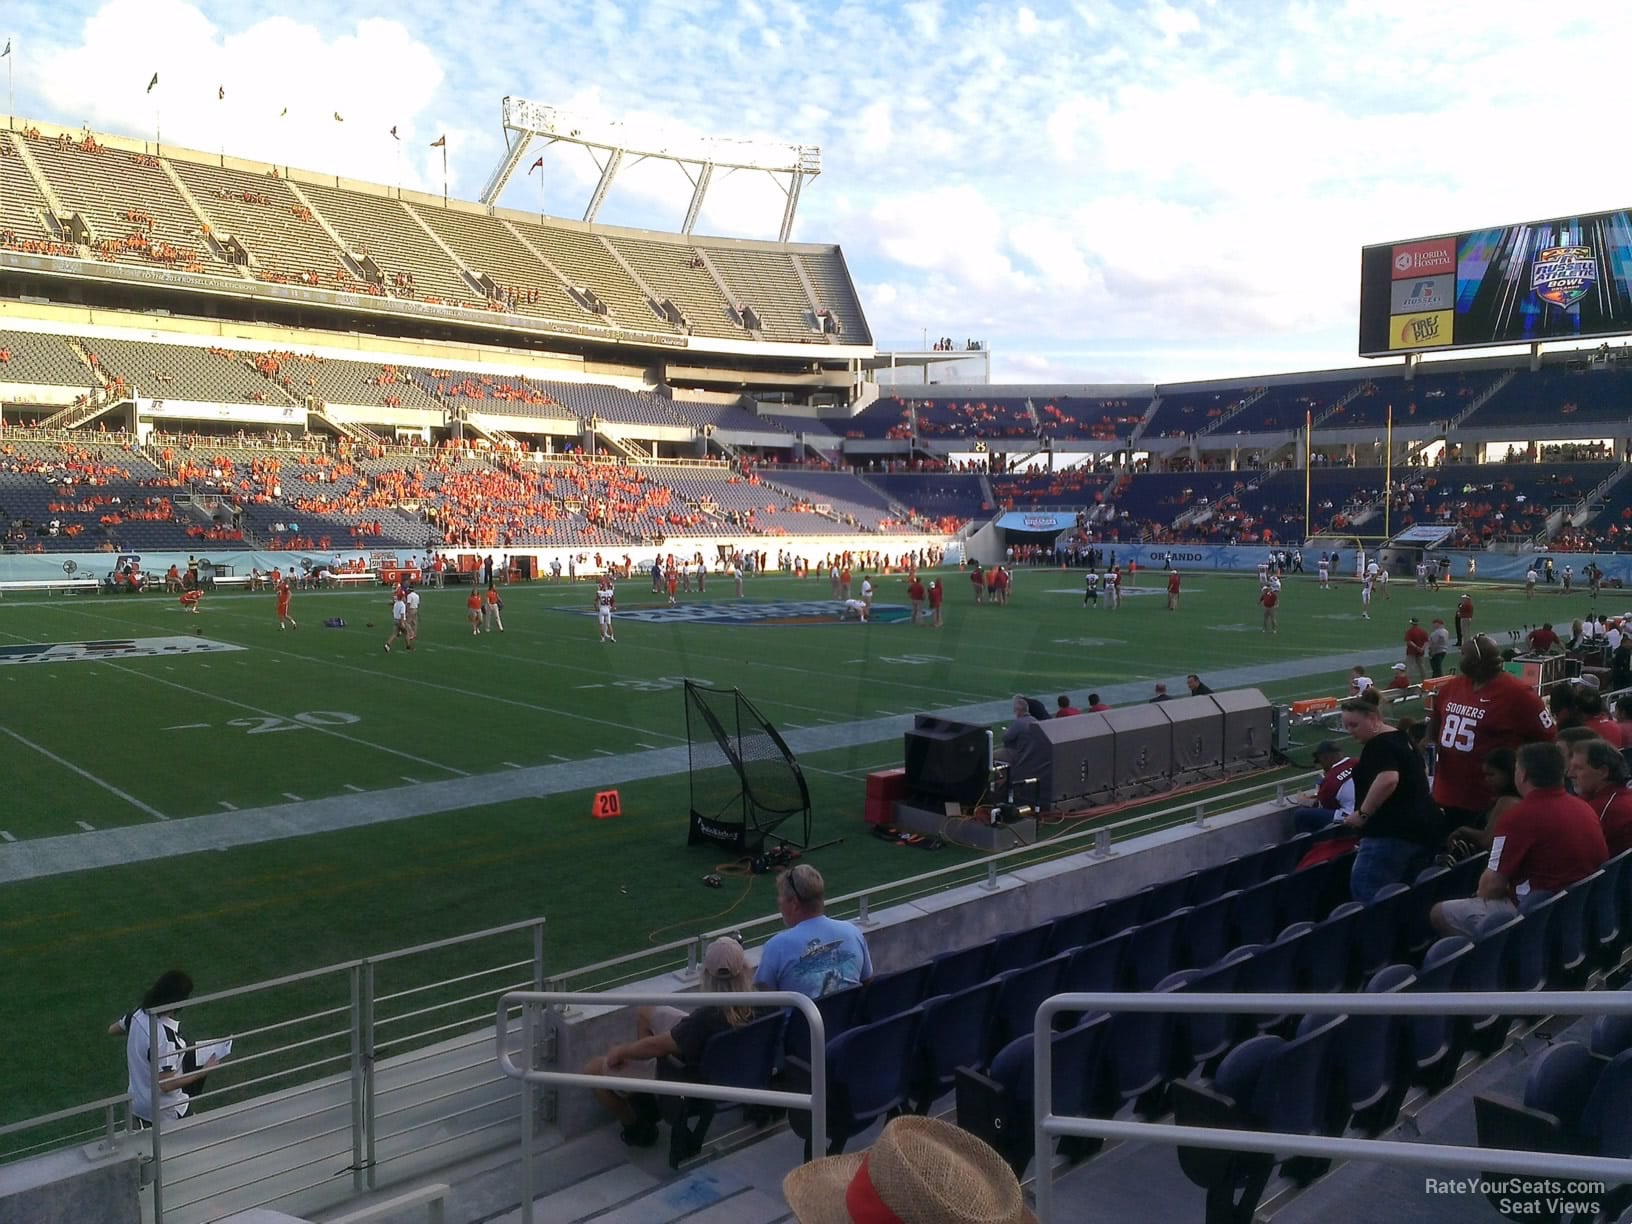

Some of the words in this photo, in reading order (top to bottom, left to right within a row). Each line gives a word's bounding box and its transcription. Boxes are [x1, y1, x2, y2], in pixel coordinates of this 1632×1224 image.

[1414, 250, 1448, 260] FLORIDA
[1414, 257, 1450, 267] HOSPITAL
[1536, 262, 1593, 275] RUSSELL
[181, 276, 208, 286] RUSSELL
[1536, 269, 1593, 281] ATHLETIC
[1548, 278, 1584, 288] BOWL
[1411, 314, 1439, 331] TIRES
[1414, 325, 1439, 341] PLUS
[1150, 551, 1203, 562] ORANDO
[1445, 702, 1486, 720] SOONERS
[227, 710, 361, 734] 20
[1440, 714, 1478, 753] 85
[598, 794, 619, 814] 20
